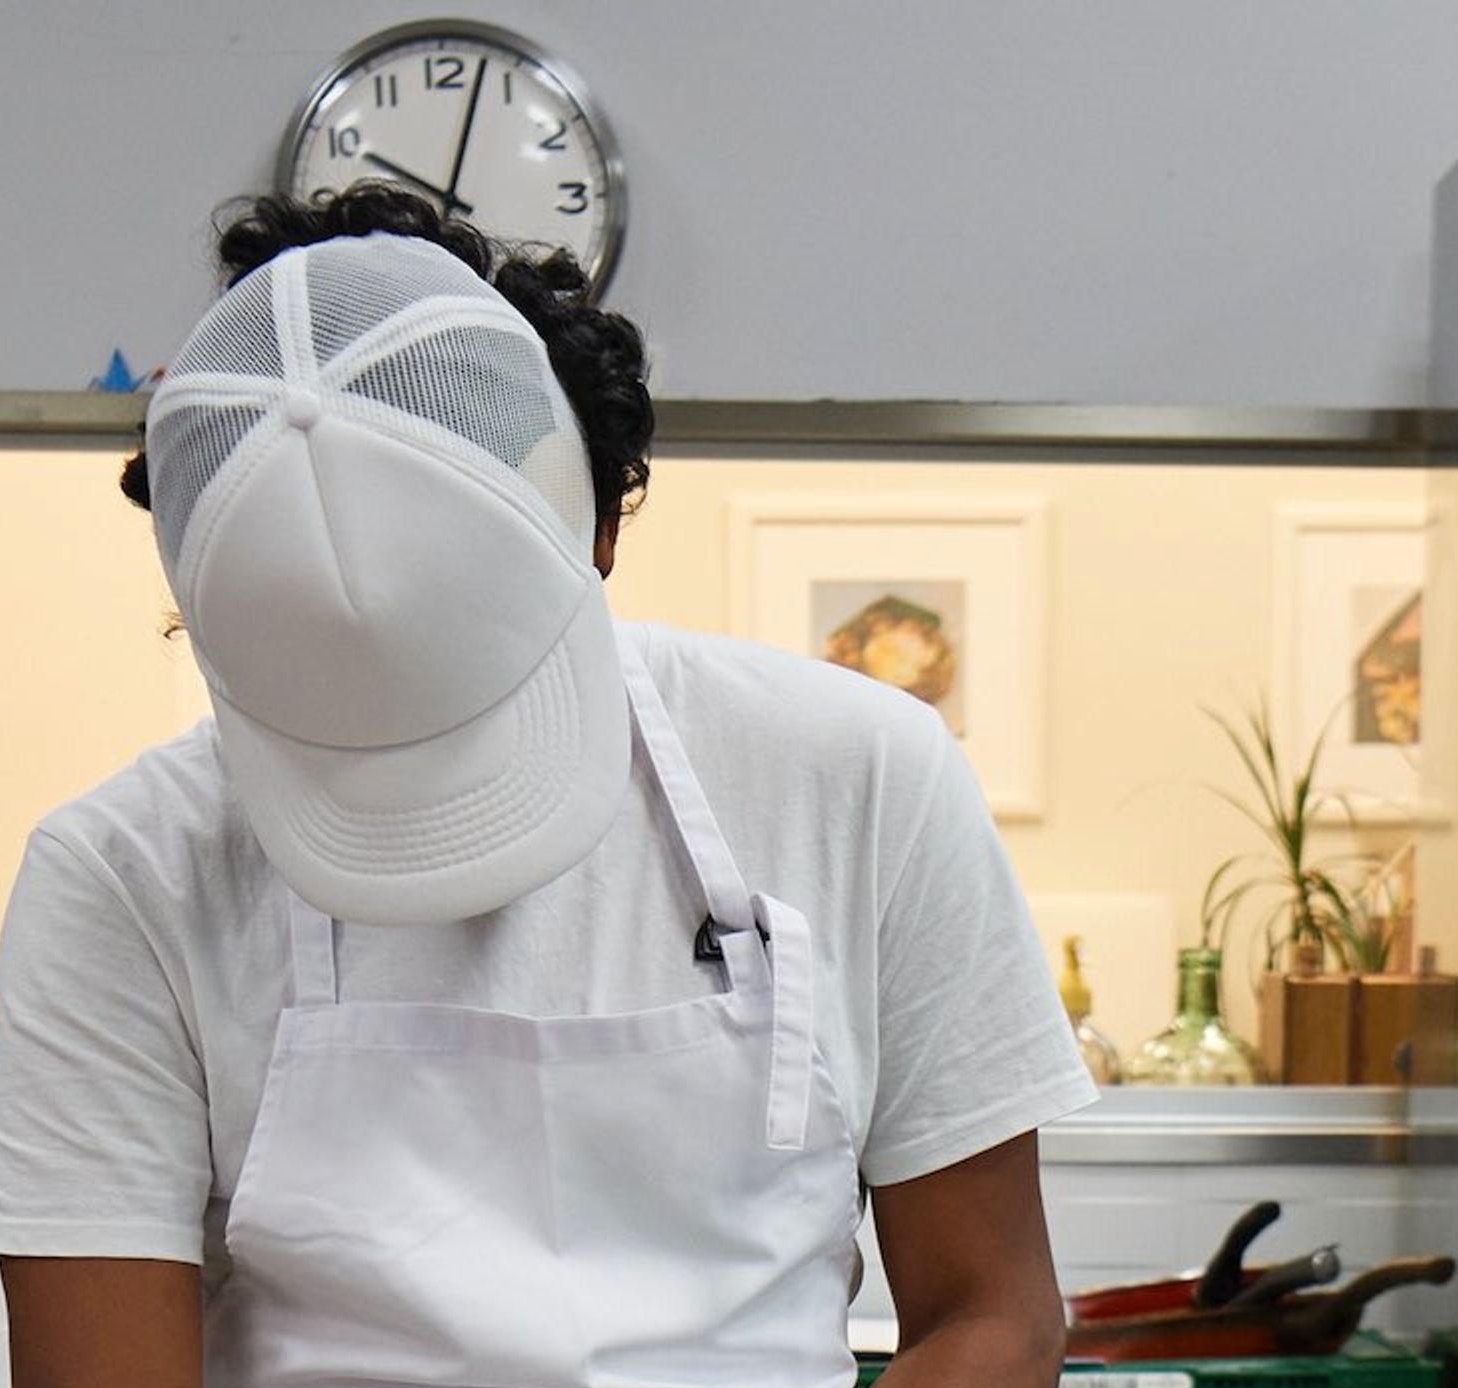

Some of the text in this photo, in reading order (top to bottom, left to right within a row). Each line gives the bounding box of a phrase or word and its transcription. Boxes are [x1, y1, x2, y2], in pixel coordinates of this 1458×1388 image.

[425, 57, 465, 89] 12
[504, 73, 512, 104] 1
[375, 75, 397, 108] 11
[329, 127, 361, 158] 10
[537, 121, 566, 150] 2
[556, 182, 589, 213] 3
